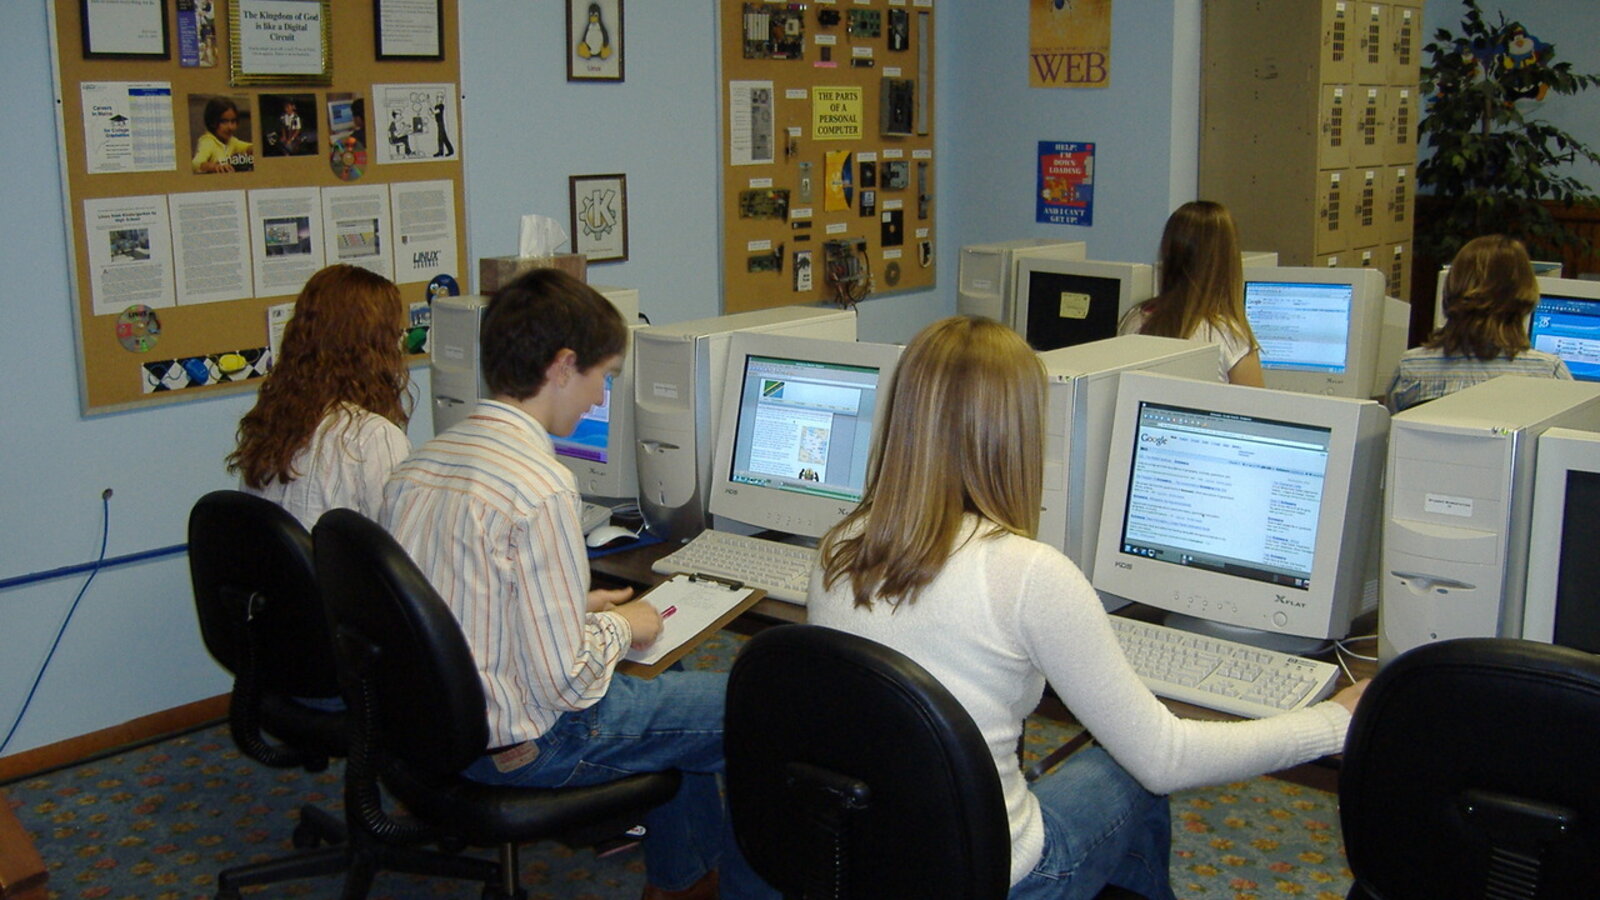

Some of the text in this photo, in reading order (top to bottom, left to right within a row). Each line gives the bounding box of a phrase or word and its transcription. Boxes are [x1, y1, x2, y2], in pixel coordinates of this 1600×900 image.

[244, 11, 319, 21] The Kingdom of God
[255, 22, 262, 30] is
[263, 22, 276, 31] like
[284, 23, 308, 32] Digital
[269, 33, 295, 41] Circuit
[1030, 51, 1107, 83] WEB
[818, 92, 858, 101] THE PARTS
[830, 103, 847, 112] OF A
[819, 114, 857, 123] PERSONAL
[818, 125, 858, 135] COMPUTER
[1055, 143, 1078, 152] HELP!
[218, 153, 255, 165] enable
[1060, 151, 1072, 159] I'M
[1053, 159, 1076, 167] DOWN
[1049, 167, 1081, 175] LOADING
[1043, 207, 1058, 215] AND
[1064, 208, 1086, 216] CAN'T
[1050, 215, 1078, 224] GET UP!
[413, 250, 439, 263] LINUX
[1141, 433, 1168, 446] Google
